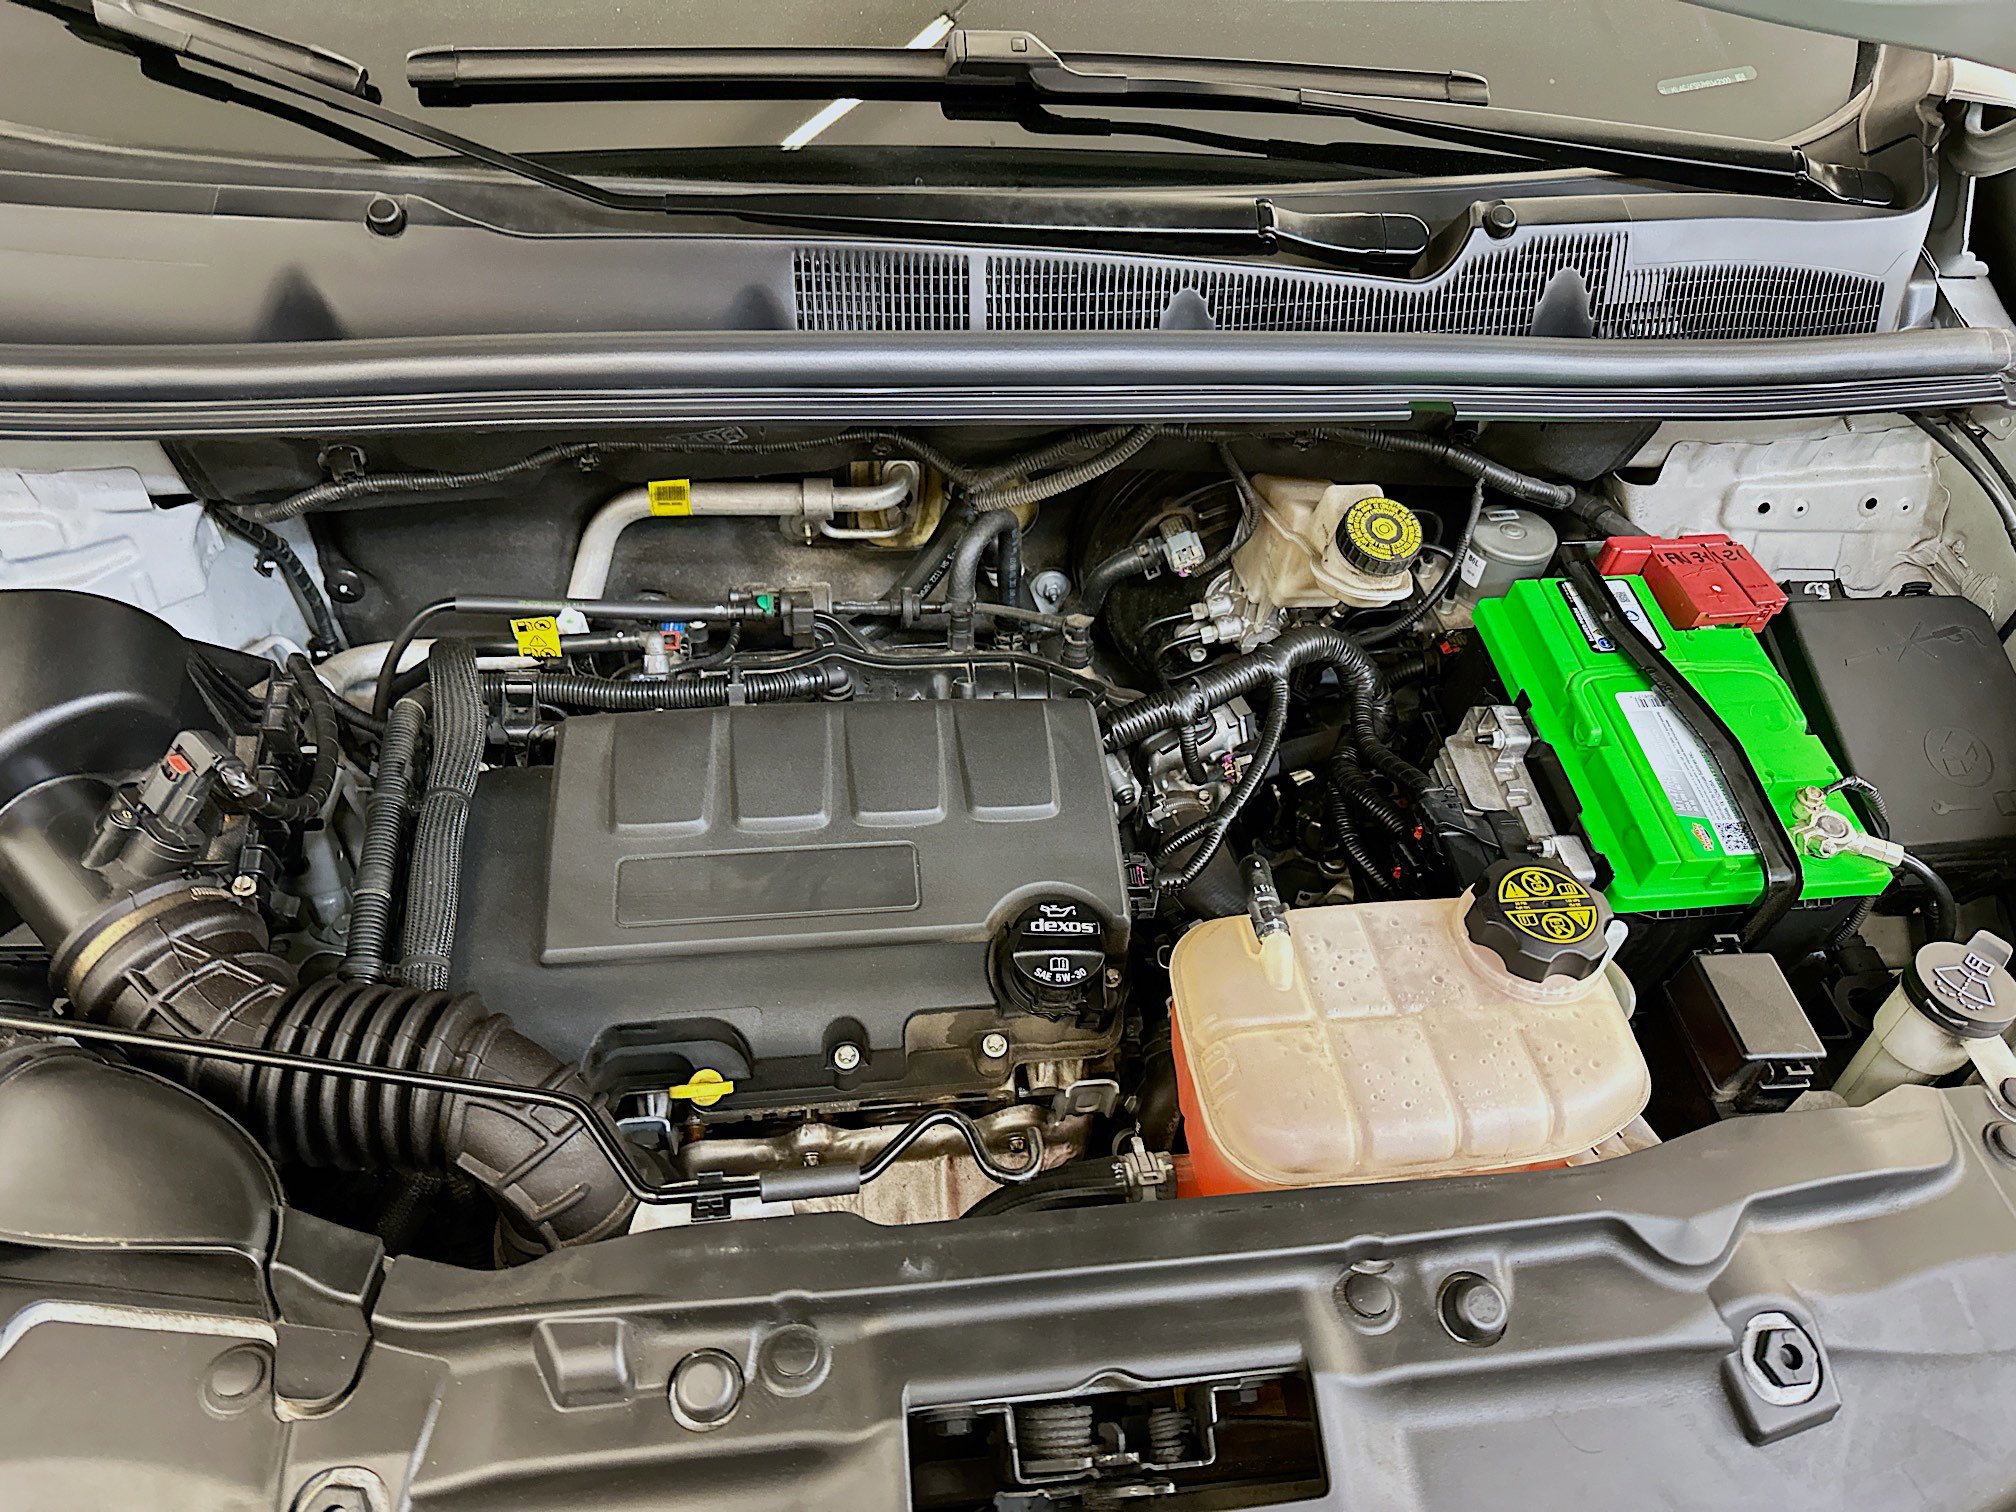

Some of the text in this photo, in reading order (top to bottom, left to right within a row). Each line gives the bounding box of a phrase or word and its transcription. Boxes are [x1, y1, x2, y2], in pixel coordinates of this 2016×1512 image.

[1030, 918, 1094, 934] dexos
[1034, 967, 1087, 982] SAE 5W-30
